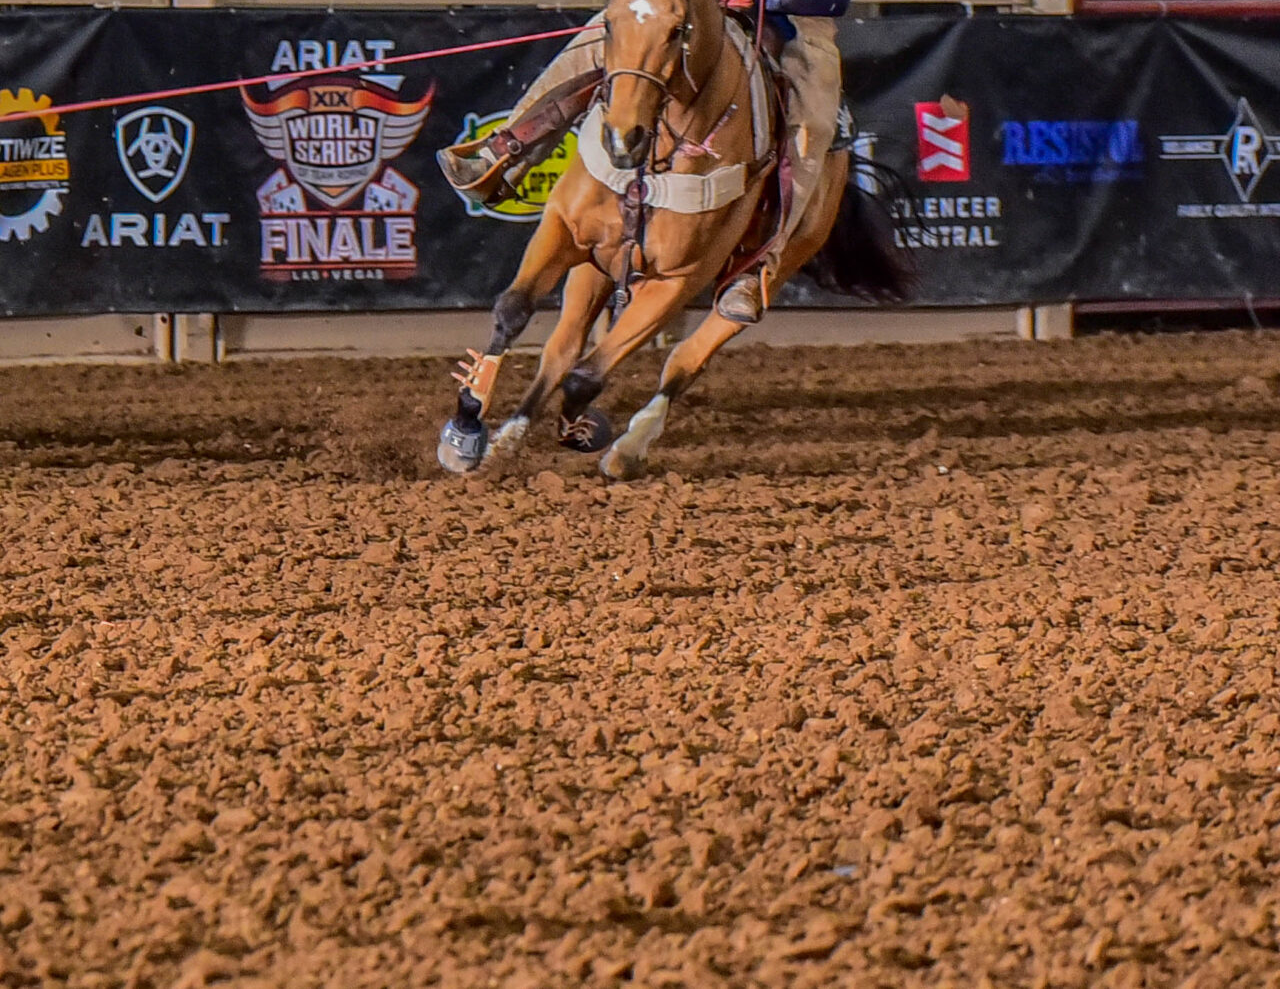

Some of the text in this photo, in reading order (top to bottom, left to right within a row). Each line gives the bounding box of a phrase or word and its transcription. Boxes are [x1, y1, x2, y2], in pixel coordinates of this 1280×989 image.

[271, 39, 396, 72] ARIAT
[314, 91, 350, 107] XIX
[287, 114, 376, 140] WORLD
[294, 139, 372, 166] SERIES
[32, 162, 66, 176] PLUS
[890, 197, 1002, 219] SIENCER
[80, 213, 231, 247] ARIAT
[260, 217, 417, 263] FINALE
[292, 269, 384, 281] LAS VEGAS
